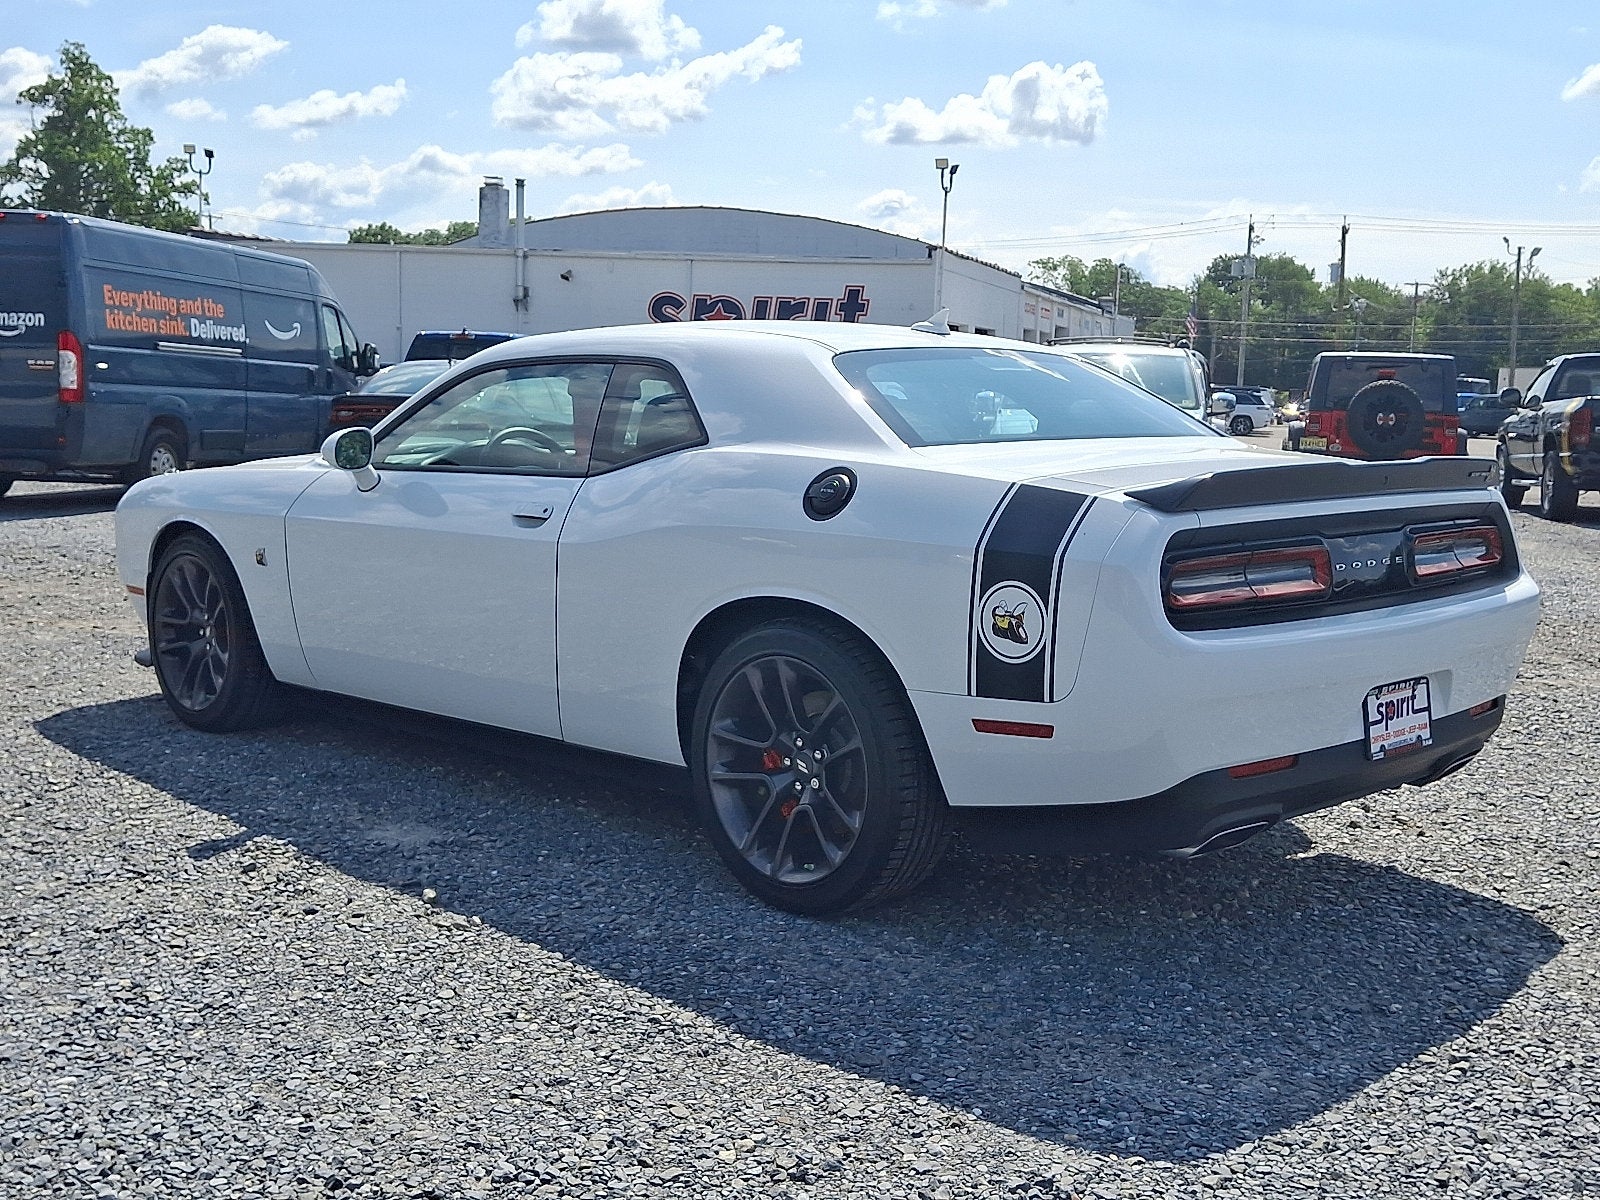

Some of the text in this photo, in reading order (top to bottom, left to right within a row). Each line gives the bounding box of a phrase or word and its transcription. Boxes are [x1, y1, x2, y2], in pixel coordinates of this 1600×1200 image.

[103, 284, 225, 318] Everything and the
[105, 309, 250, 344] kitchen sink. Delivered.
[1335, 556, 1404, 571] DODGE
[1373, 693, 1425, 731] spirit
